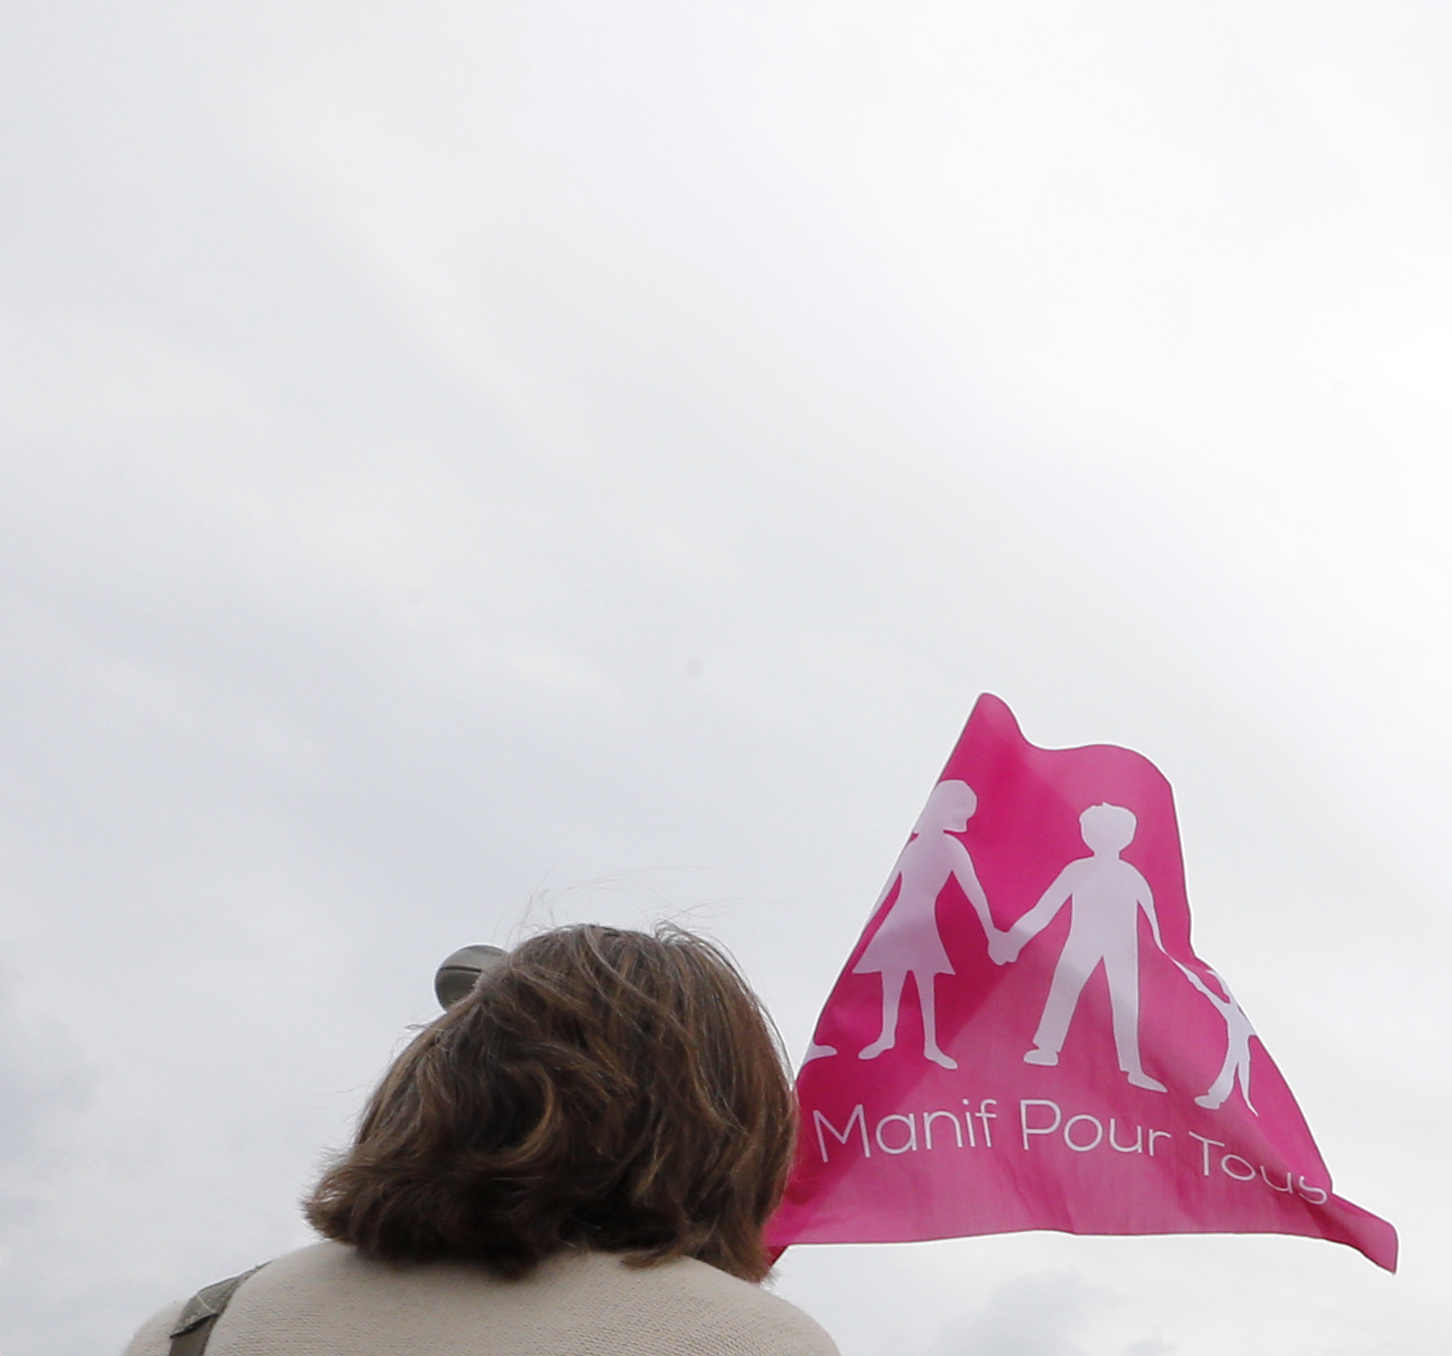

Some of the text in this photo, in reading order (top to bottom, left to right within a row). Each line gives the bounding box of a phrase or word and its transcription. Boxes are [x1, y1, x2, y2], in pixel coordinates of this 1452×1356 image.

[812, 1098, 1328, 1206] Manif Pour Tous
